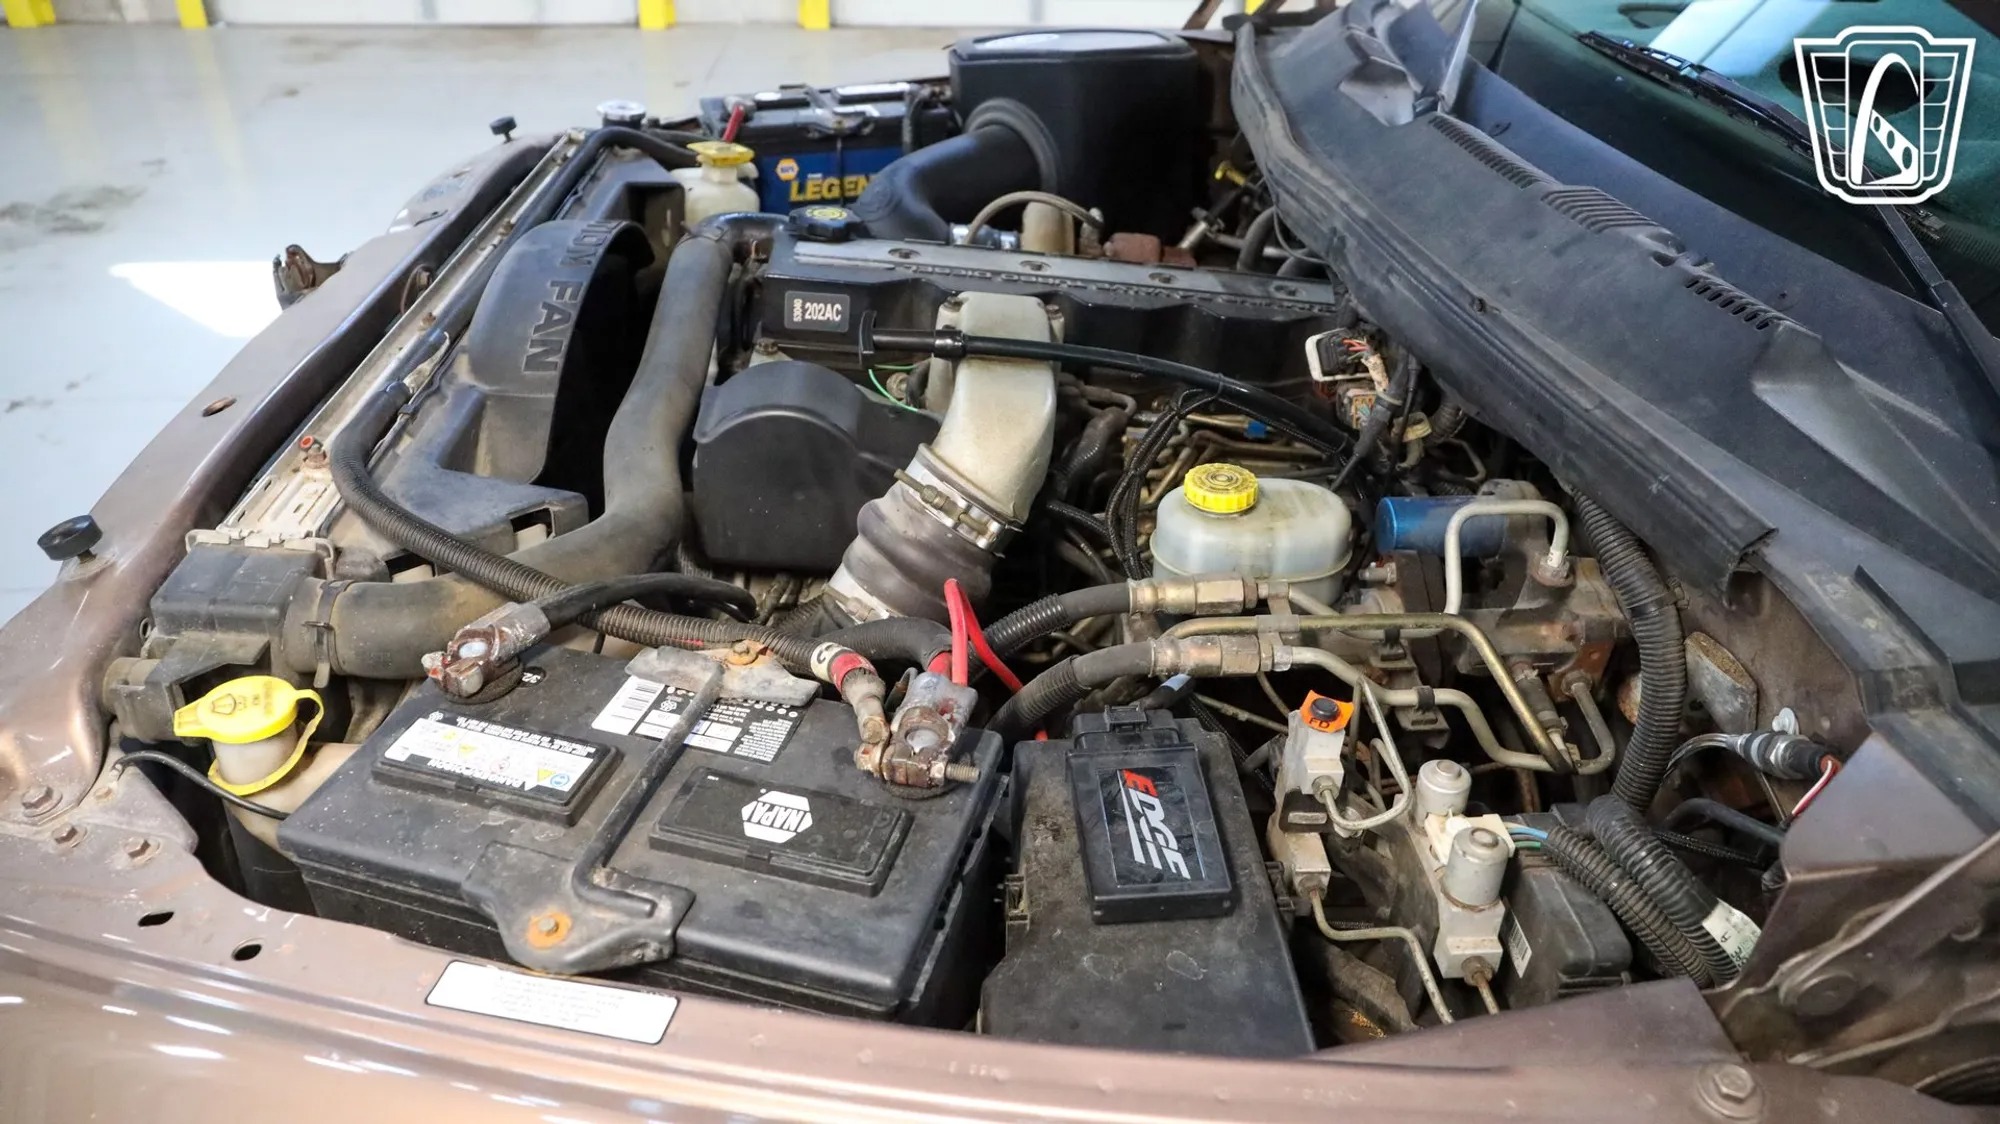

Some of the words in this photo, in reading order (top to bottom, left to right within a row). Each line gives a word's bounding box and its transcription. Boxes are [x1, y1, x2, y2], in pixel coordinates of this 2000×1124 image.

[522, 280, 584, 373] FAN
[804, 302, 842, 321] 202AC
[750, 802, 804, 832] NAPA
[1122, 768, 1191, 879] EDGE
